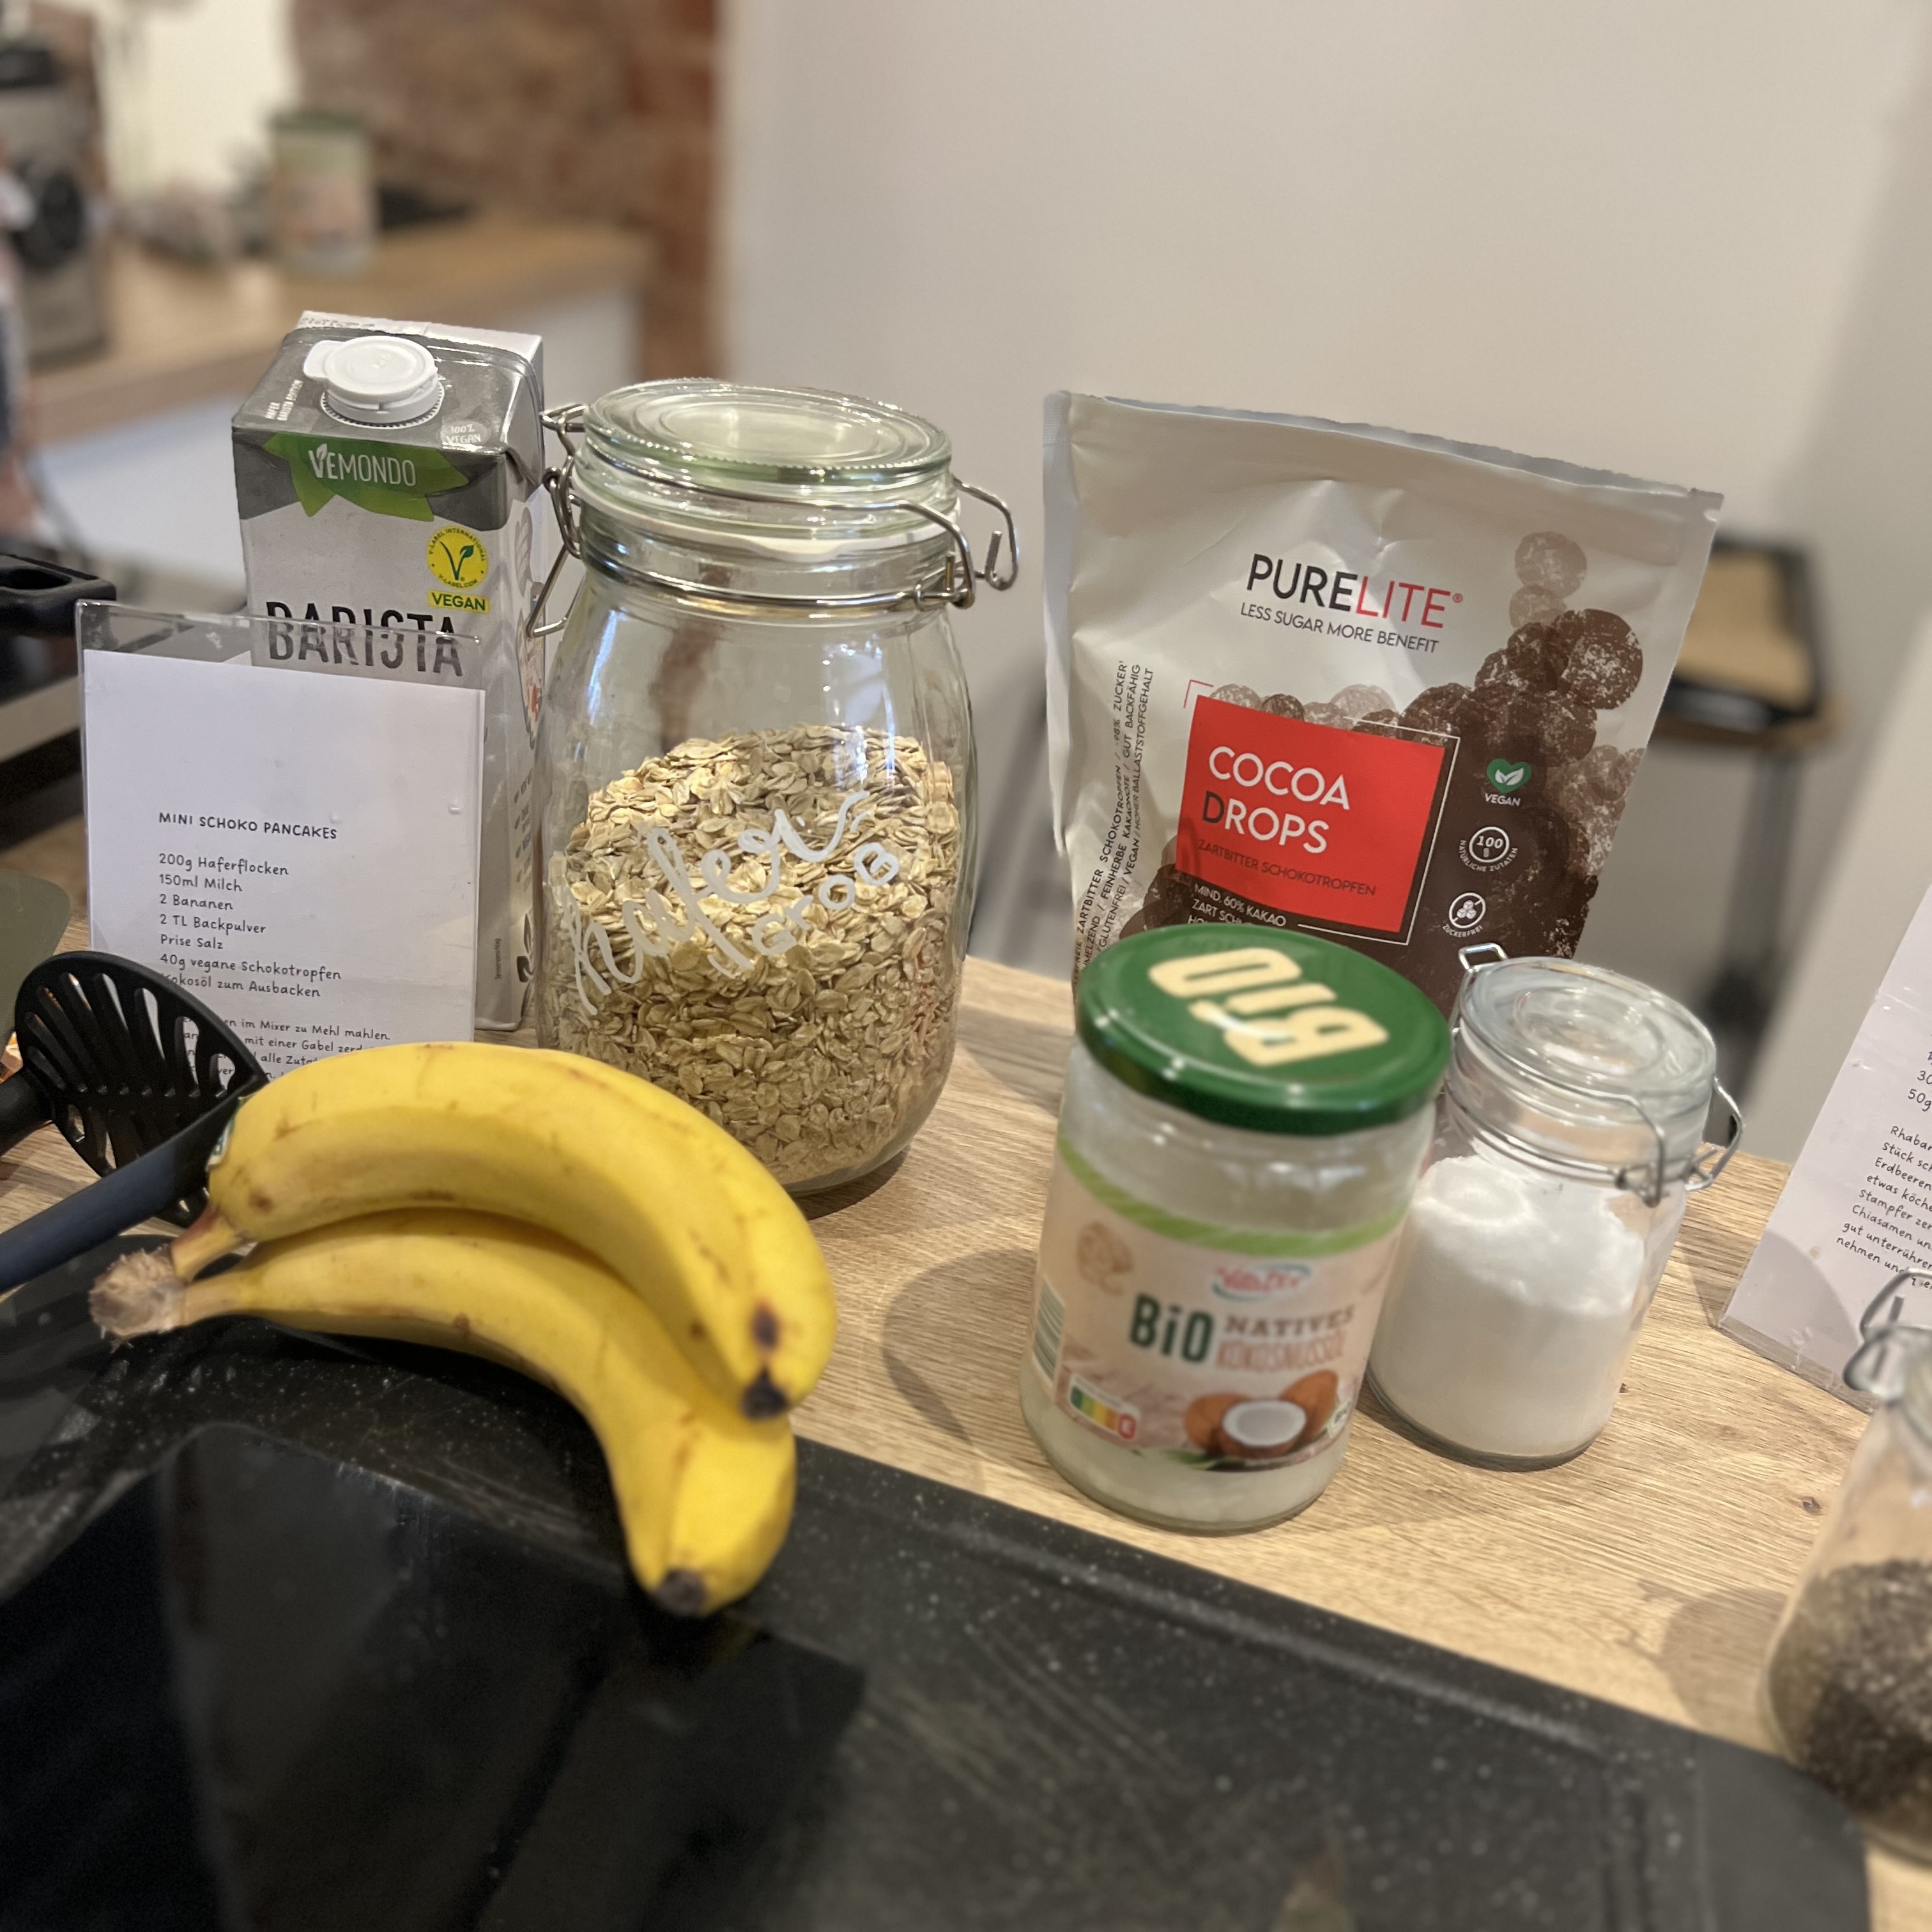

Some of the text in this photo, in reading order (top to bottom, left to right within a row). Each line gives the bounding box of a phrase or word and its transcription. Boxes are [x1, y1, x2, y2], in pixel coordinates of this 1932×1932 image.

[446, 434, 481, 445] VEGAN
[450, 424, 475, 434] 100%
[309, 443, 416, 486] VEMONDO
[431, 592, 486, 611] VEGAN
[266, 602, 463, 677] BARISTA
[1241, 602, 1439, 653] LESS SUGAR MORE BENEFIT
[1125, 664, 1140, 728] BACKFÄHIG
[1123, 734, 1132, 758] GUT
[1208, 746, 1350, 810] COCOA
[1484, 793, 1521, 807] VEGAN
[159, 813, 338, 839] MINI SCHOKO PANCAKES
[1202, 790, 1329, 854] DROPS
[1077, 869, 1104, 934] ZARTBITTER
[1100, 765, 1124, 862] SCHOKOTROPFEN
[1476, 836, 1503, 848] 100
[159, 853, 289, 875] 200g Haferflocken
[1198, 839, 1376, 897] ZARTBITTER SCHOKOTROPFEN
[1489, 847, 1518, 871] ZUTATEN
[160, 874, 243, 892] 150ml Milch
[1101, 843, 1126, 900] FEINHERBE
[160, 893, 233, 910] 2 Bananen
[1099, 884, 1126, 947] GLUTENFREI
[1124, 838, 1139, 875] VEGAN
[1192, 898, 1219, 917] ZART
[1223, 896, 1245, 912] 60%
[1246, 905, 1287, 926] KAKAO
[160, 914, 266, 935] 2 TL Backpulver
[1442, 923, 1483, 938] ZUCKERFREI
[160, 934, 224, 949] Prise Salz
[1083, 916, 1100, 966] MELZEND
[160, 954, 342, 983] 40g vegane Schokotropfen
[161, 973, 321, 997] okosöl zum Ausbacken
[241, 1018, 256, 1029] im
[260, 1020, 291, 1032] Mixer
[312, 1025, 340, 1036] Mehl
[345, 1028, 391, 1040] mahlen.
[245, 1037, 264, 1046] mit
[268, 1038, 298, 1049] einer
[302, 1040, 334, 1052] Gabel
[261, 1053, 282, 1064] alle
[1908, 1088, 1931, 1112] 50g
[1883, 1142, 1914, 1163] Stück
[1866, 1175, 1899, 1194] etwas
[1875, 1156, 1931, 1191] Erdbeeren
[1859, 1189, 1913, 1220] Stampfer
[1842, 1222, 1864, 1236] gut
[1852, 1204, 1912, 1240] Chiasamen
[1836, 1236, 1908, 1275] nehmen un
